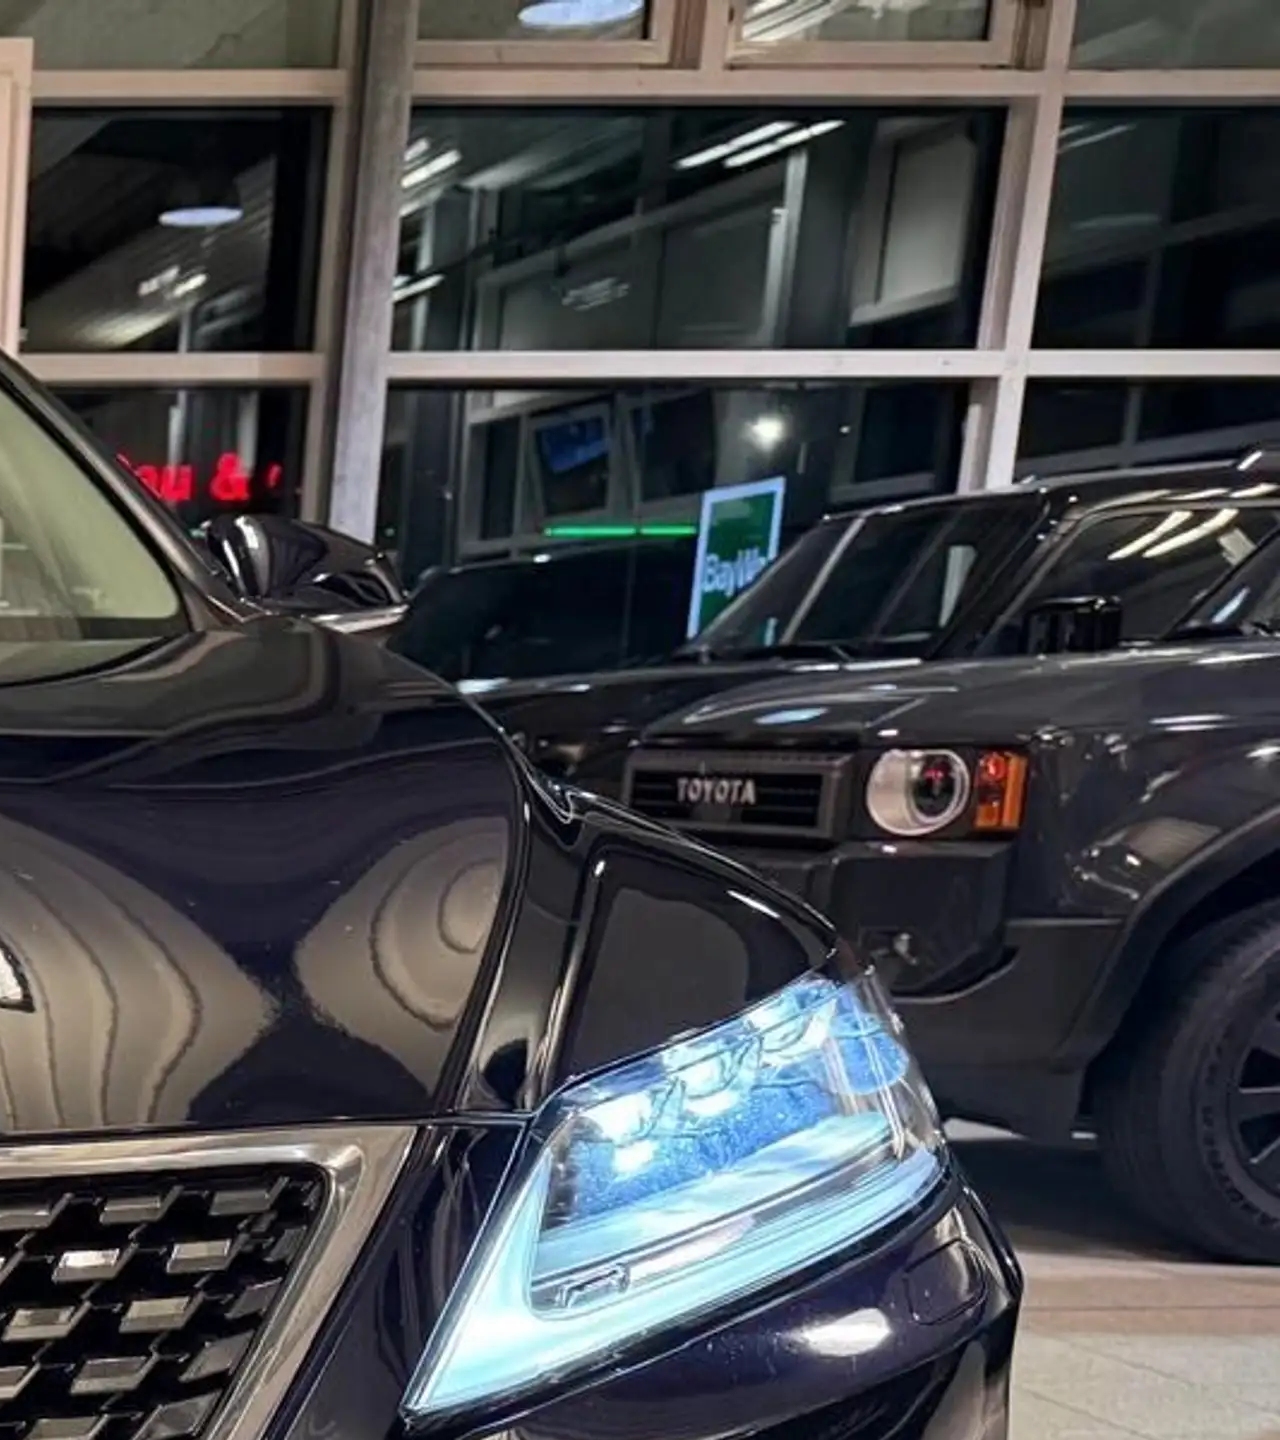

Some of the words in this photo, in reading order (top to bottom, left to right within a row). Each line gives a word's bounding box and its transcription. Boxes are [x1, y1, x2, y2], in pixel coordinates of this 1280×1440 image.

[210, 452, 250, 501] &
[702, 546, 767, 596] BayW
[677, 776, 757, 805] TOYOTA
